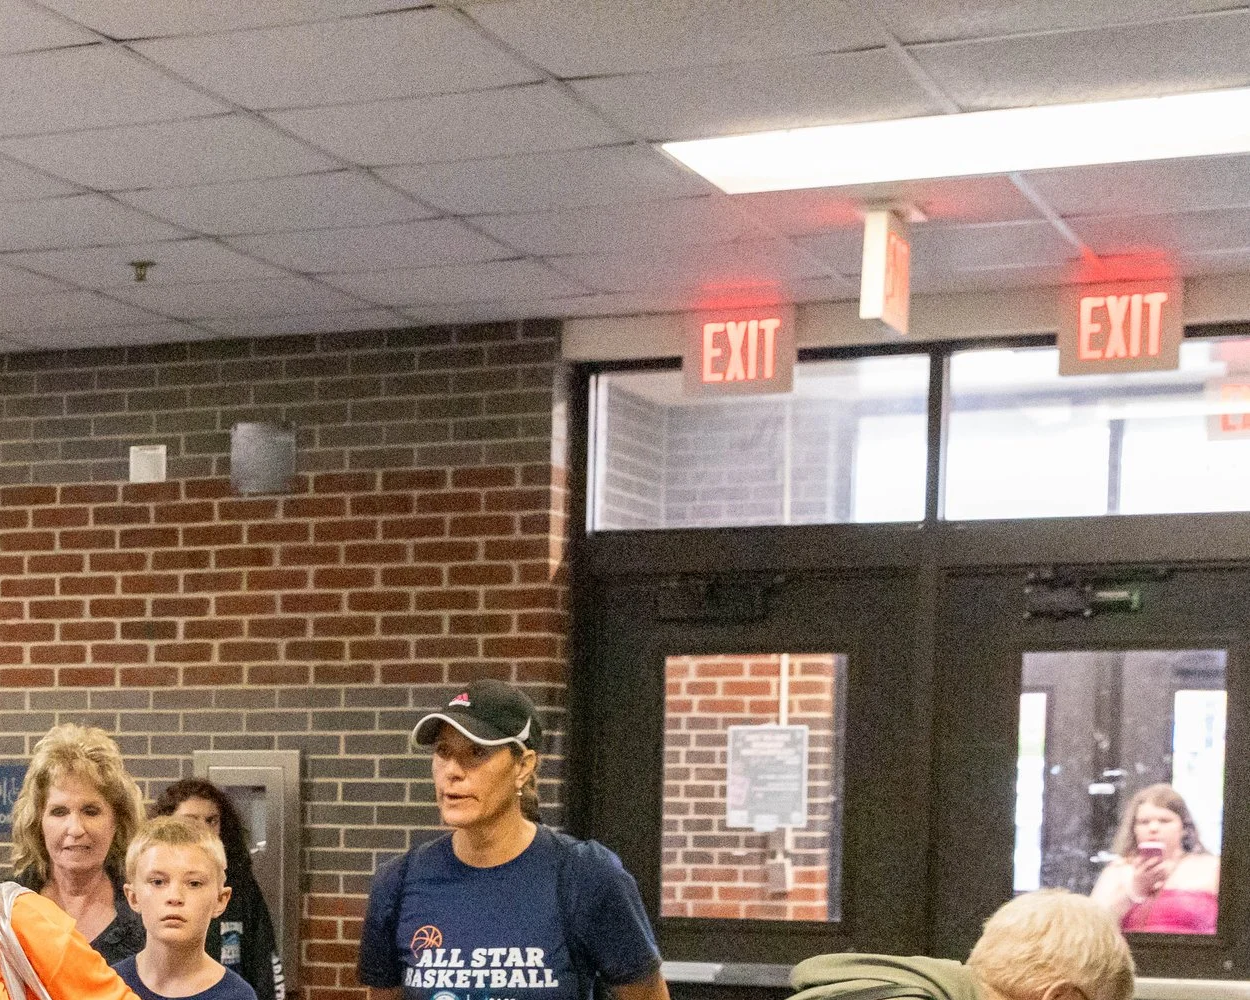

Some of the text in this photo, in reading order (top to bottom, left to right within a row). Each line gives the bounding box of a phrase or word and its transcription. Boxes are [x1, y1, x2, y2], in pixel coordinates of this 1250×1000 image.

[1079, 292, 1168, 360] EXIT
[701, 318, 780, 384] EXIT
[404, 967, 559, 989] BASKETBALL
[415, 947, 545, 968] ALL STAR
